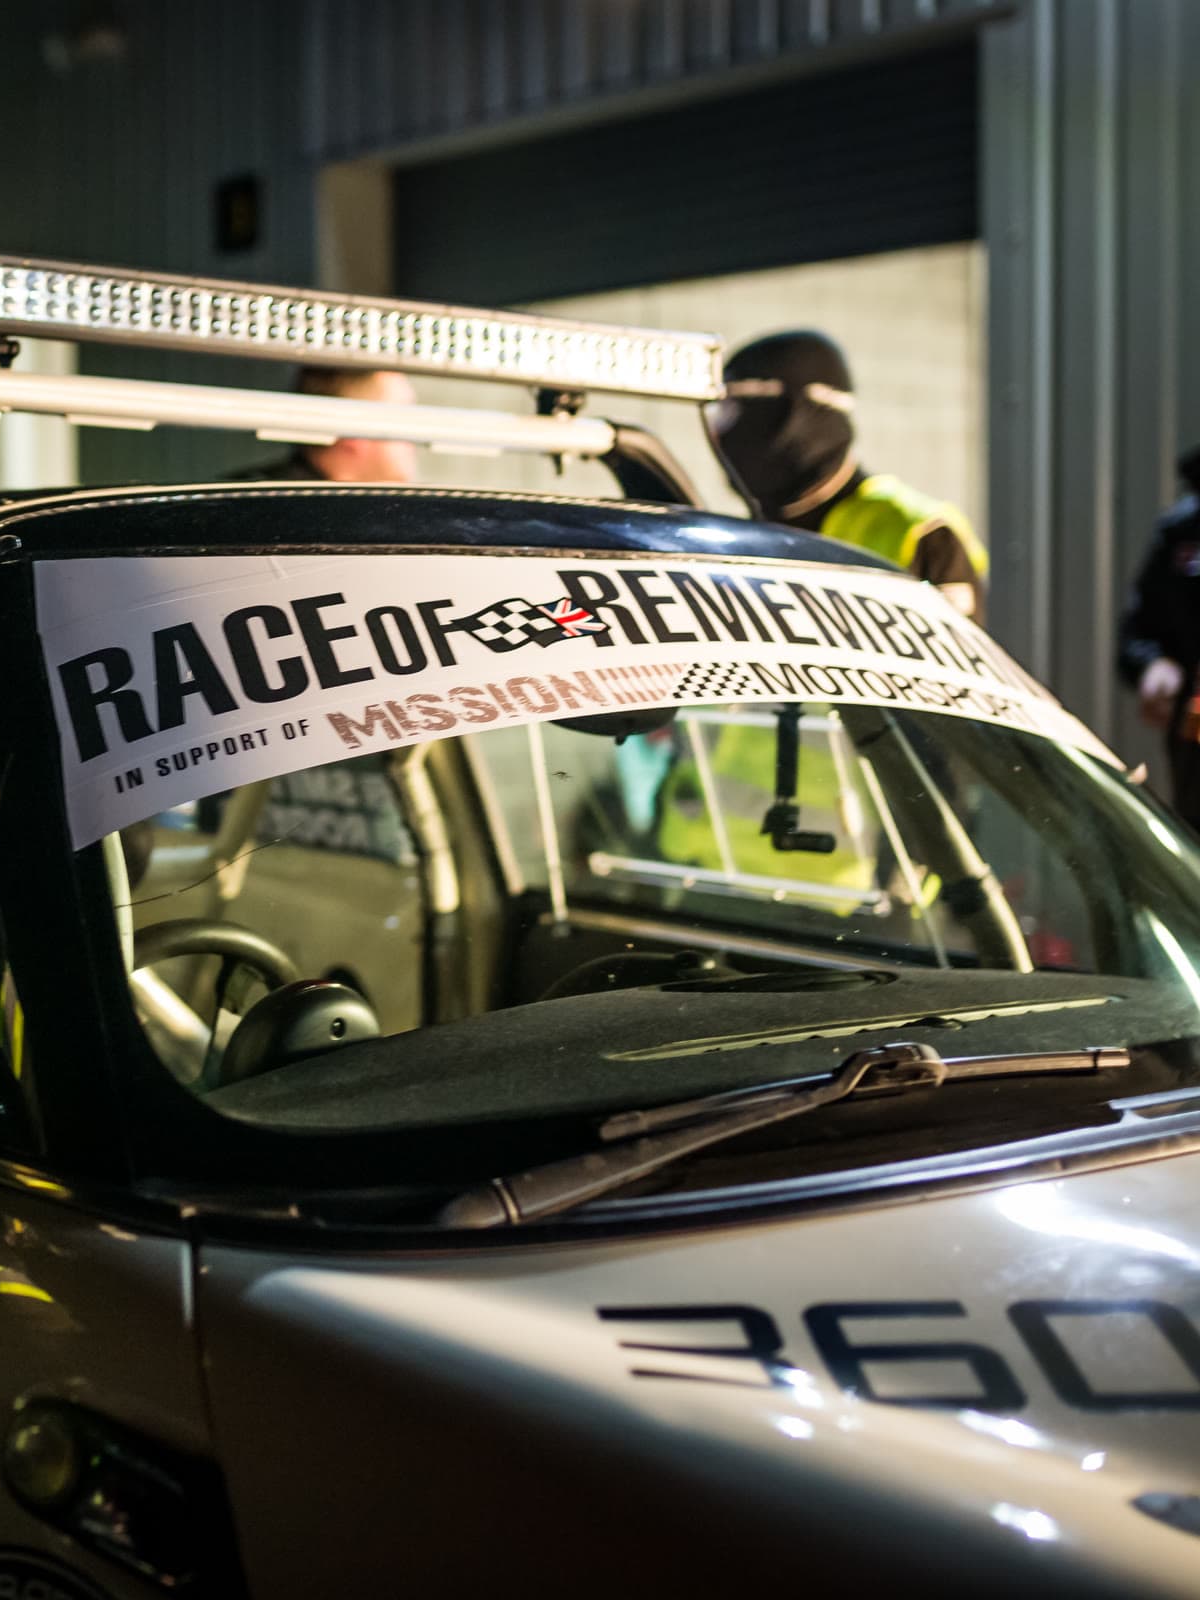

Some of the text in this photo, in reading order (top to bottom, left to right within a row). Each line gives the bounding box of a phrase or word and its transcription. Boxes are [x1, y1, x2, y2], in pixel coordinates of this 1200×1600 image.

[58, 593, 372, 762] RACE
[365, 600, 455, 676] OF
[115, 766, 143, 793] IN
[158, 725, 271, 777] SUPPORT
[281, 719, 310, 742] OF
[325, 670, 605, 749] MISSION
[596, 1301, 1200, 1413] 360
